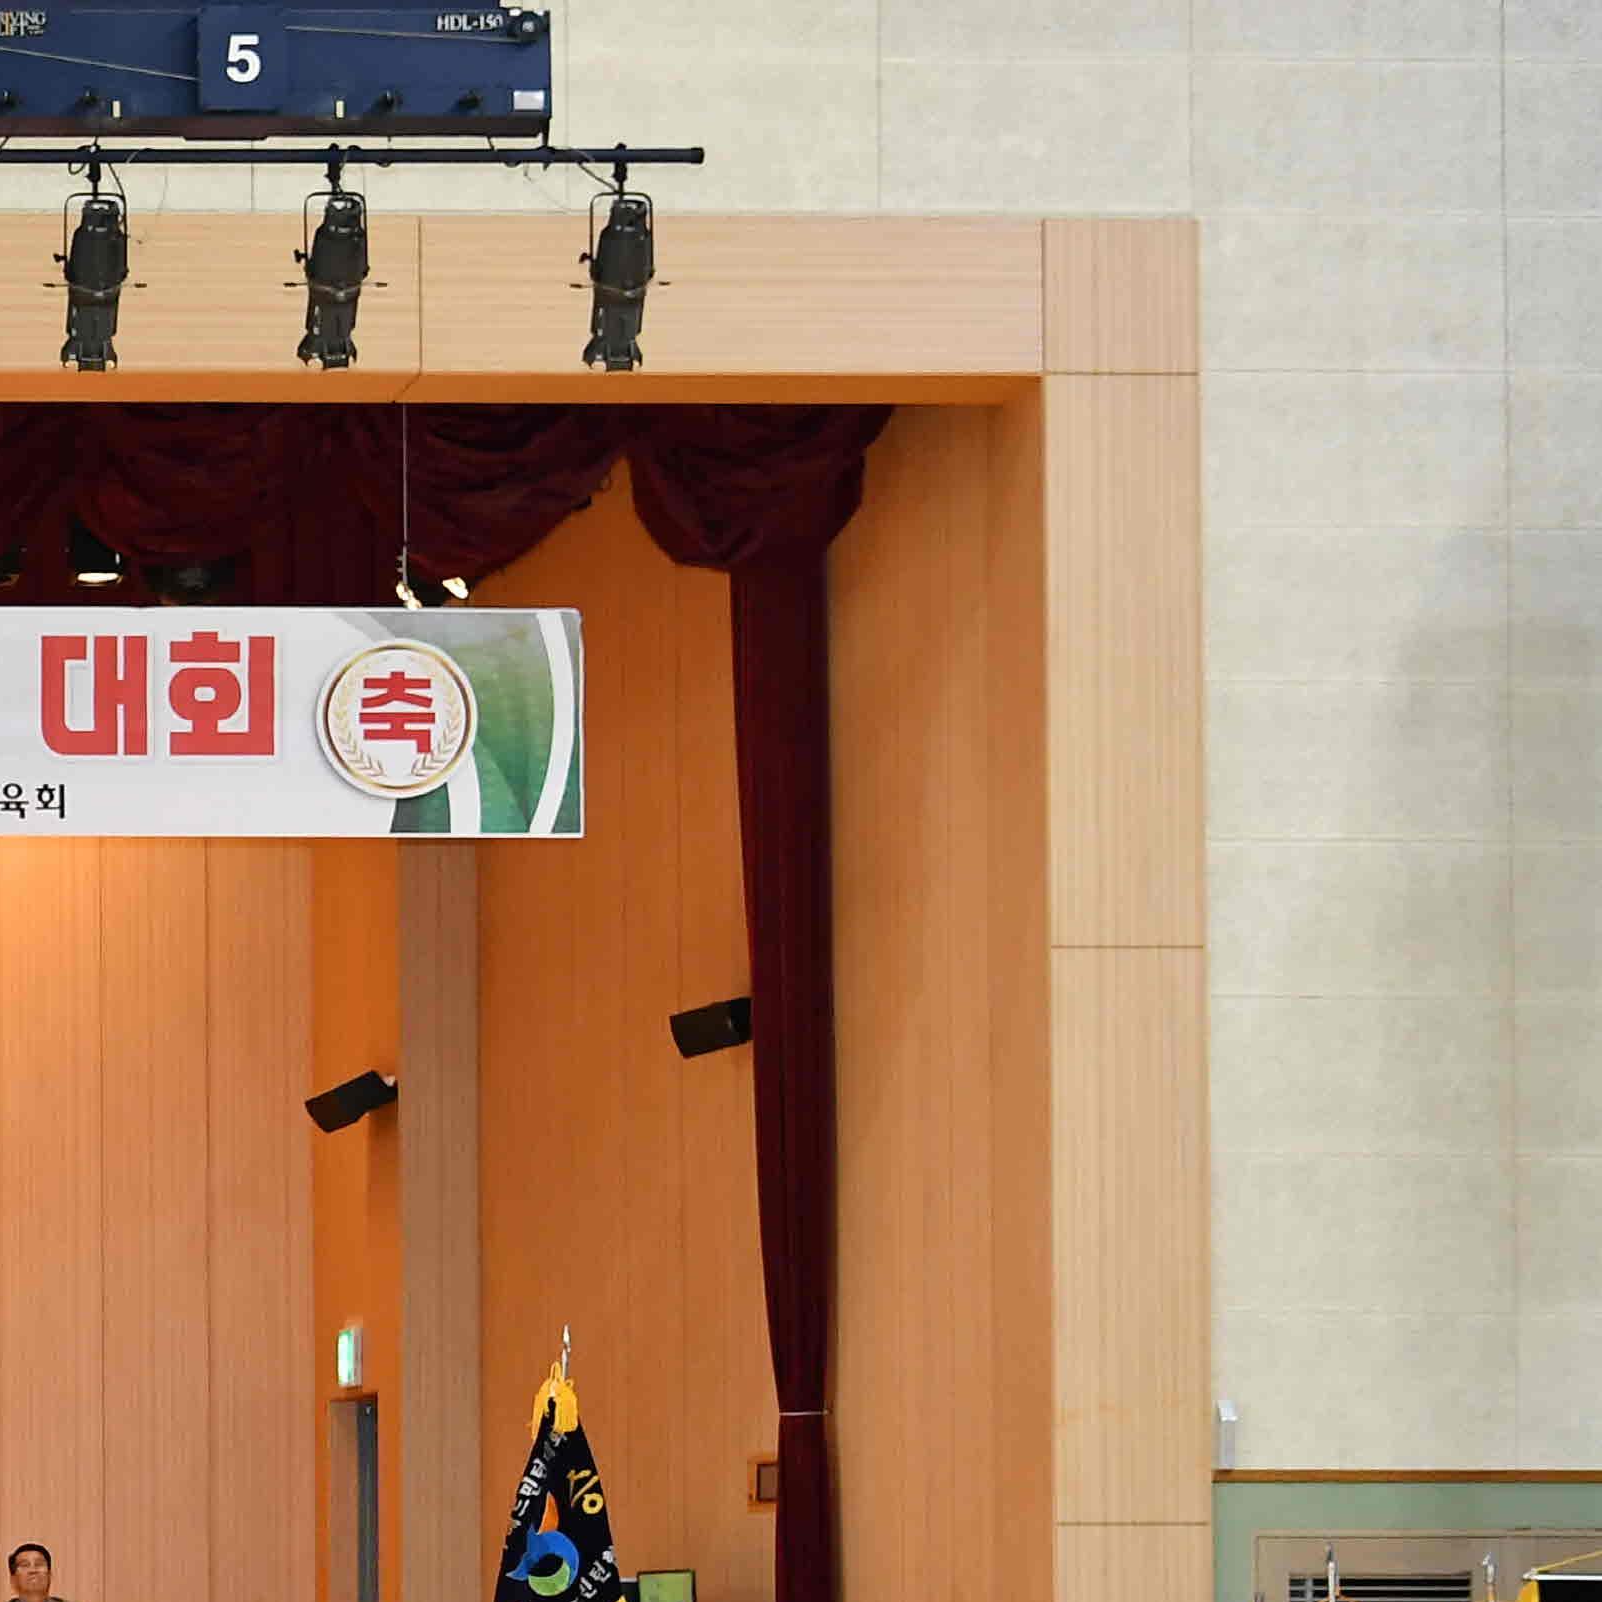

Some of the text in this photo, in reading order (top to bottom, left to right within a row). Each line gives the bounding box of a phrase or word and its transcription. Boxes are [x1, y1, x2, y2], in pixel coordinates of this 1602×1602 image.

[226, 34, 261, 83] 5
[41, 630, 275, 756] 대회
[359, 671, 434, 752] 축
